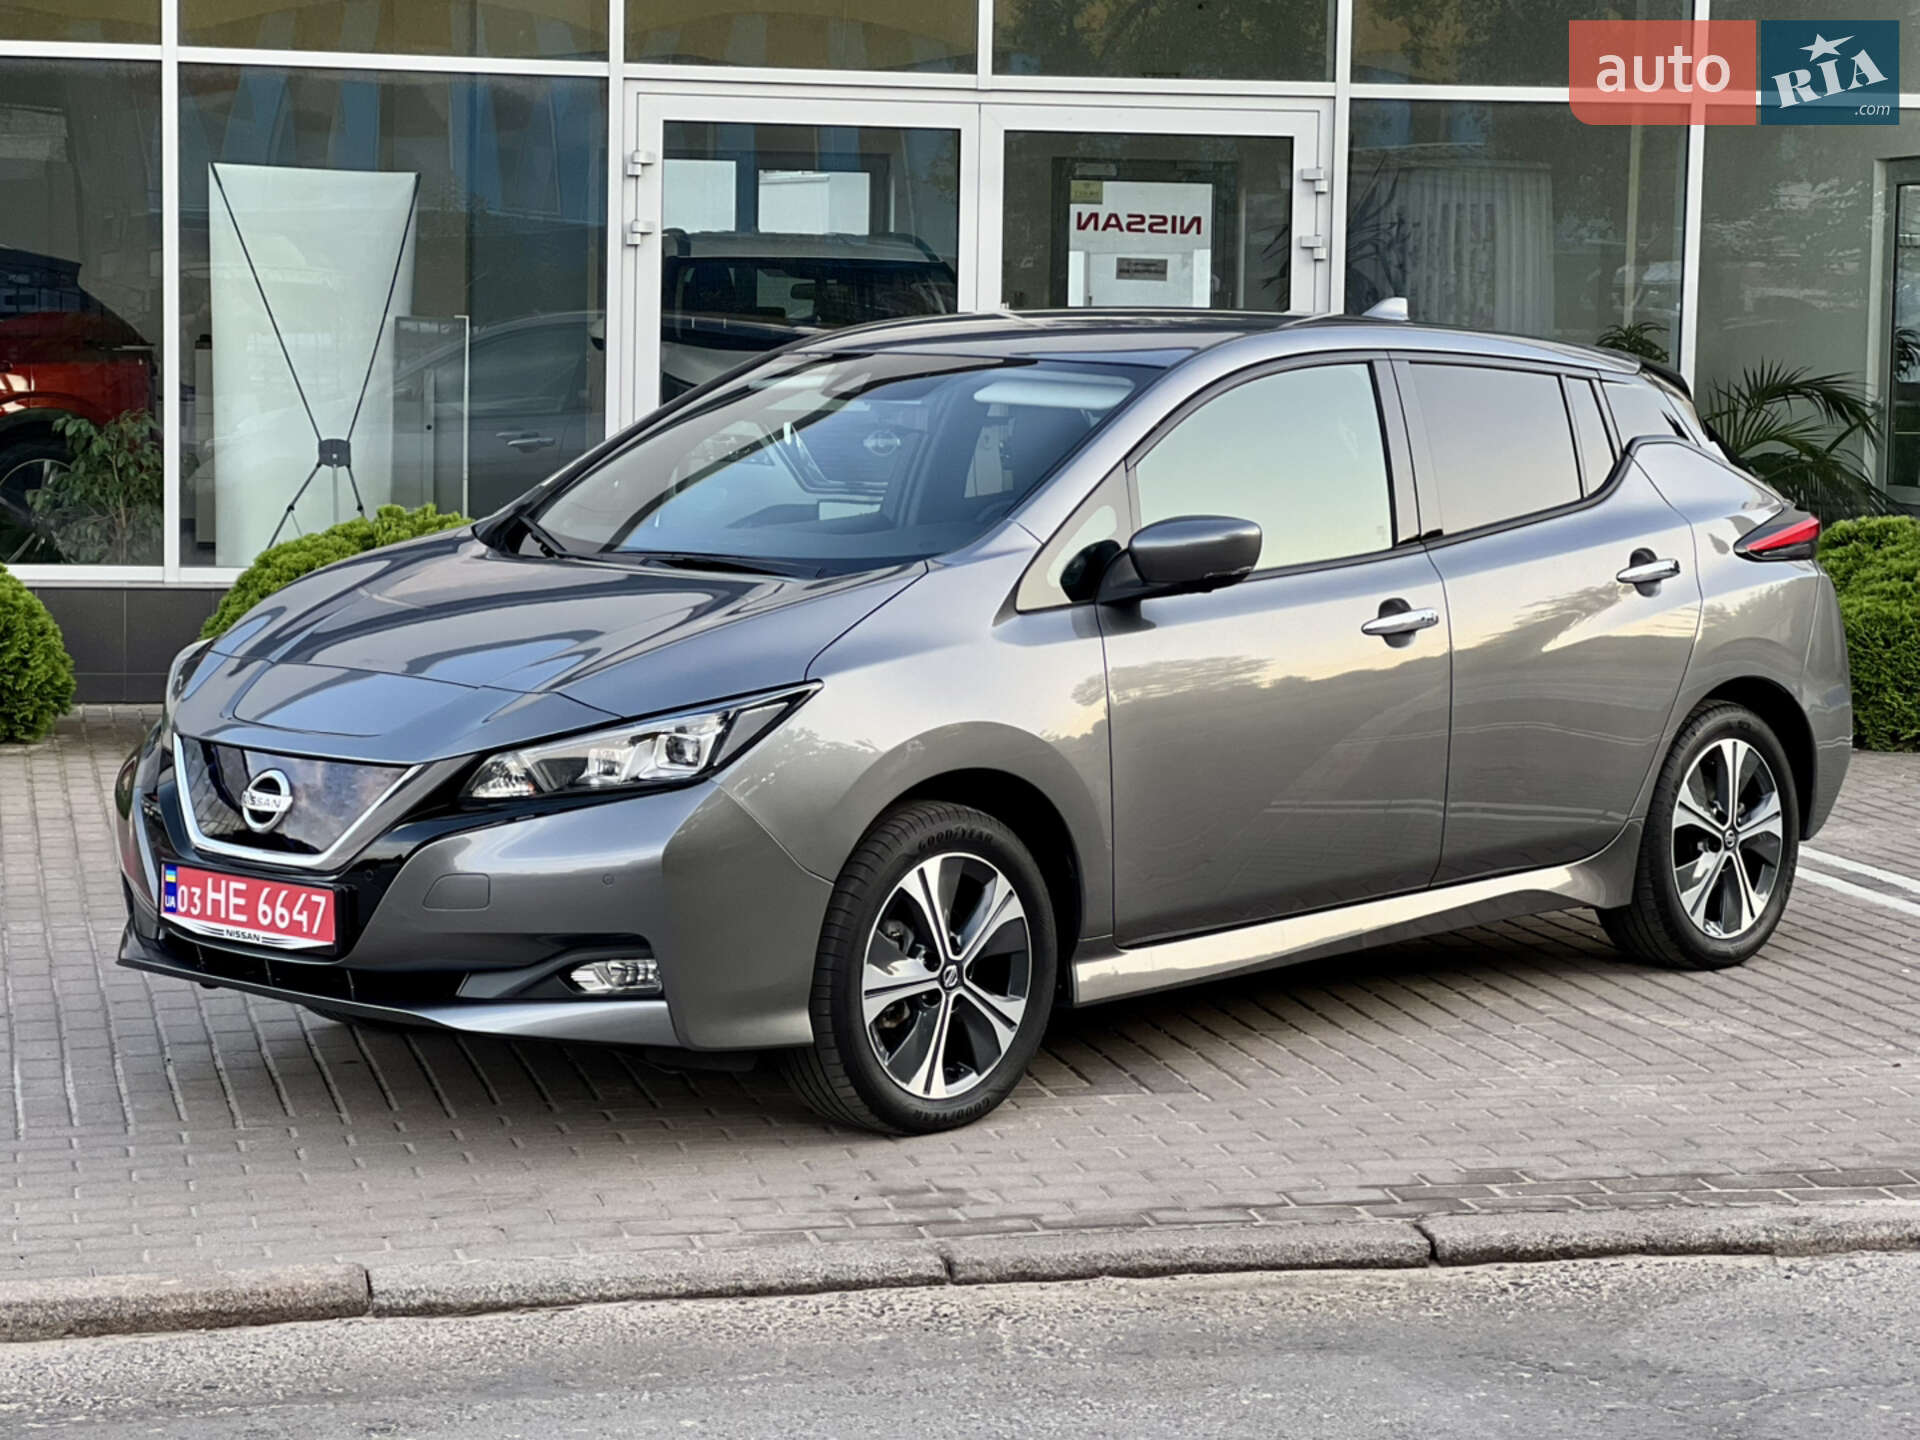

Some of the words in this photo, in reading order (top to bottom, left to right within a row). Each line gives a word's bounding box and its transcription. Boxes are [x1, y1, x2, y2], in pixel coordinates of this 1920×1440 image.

[164, 895, 176, 908] UA
[177, 885, 202, 916] 03
[206, 877, 248, 923] HE
[257, 887, 327, 935] 6647
[225, 928, 261, 942] NISSAN
